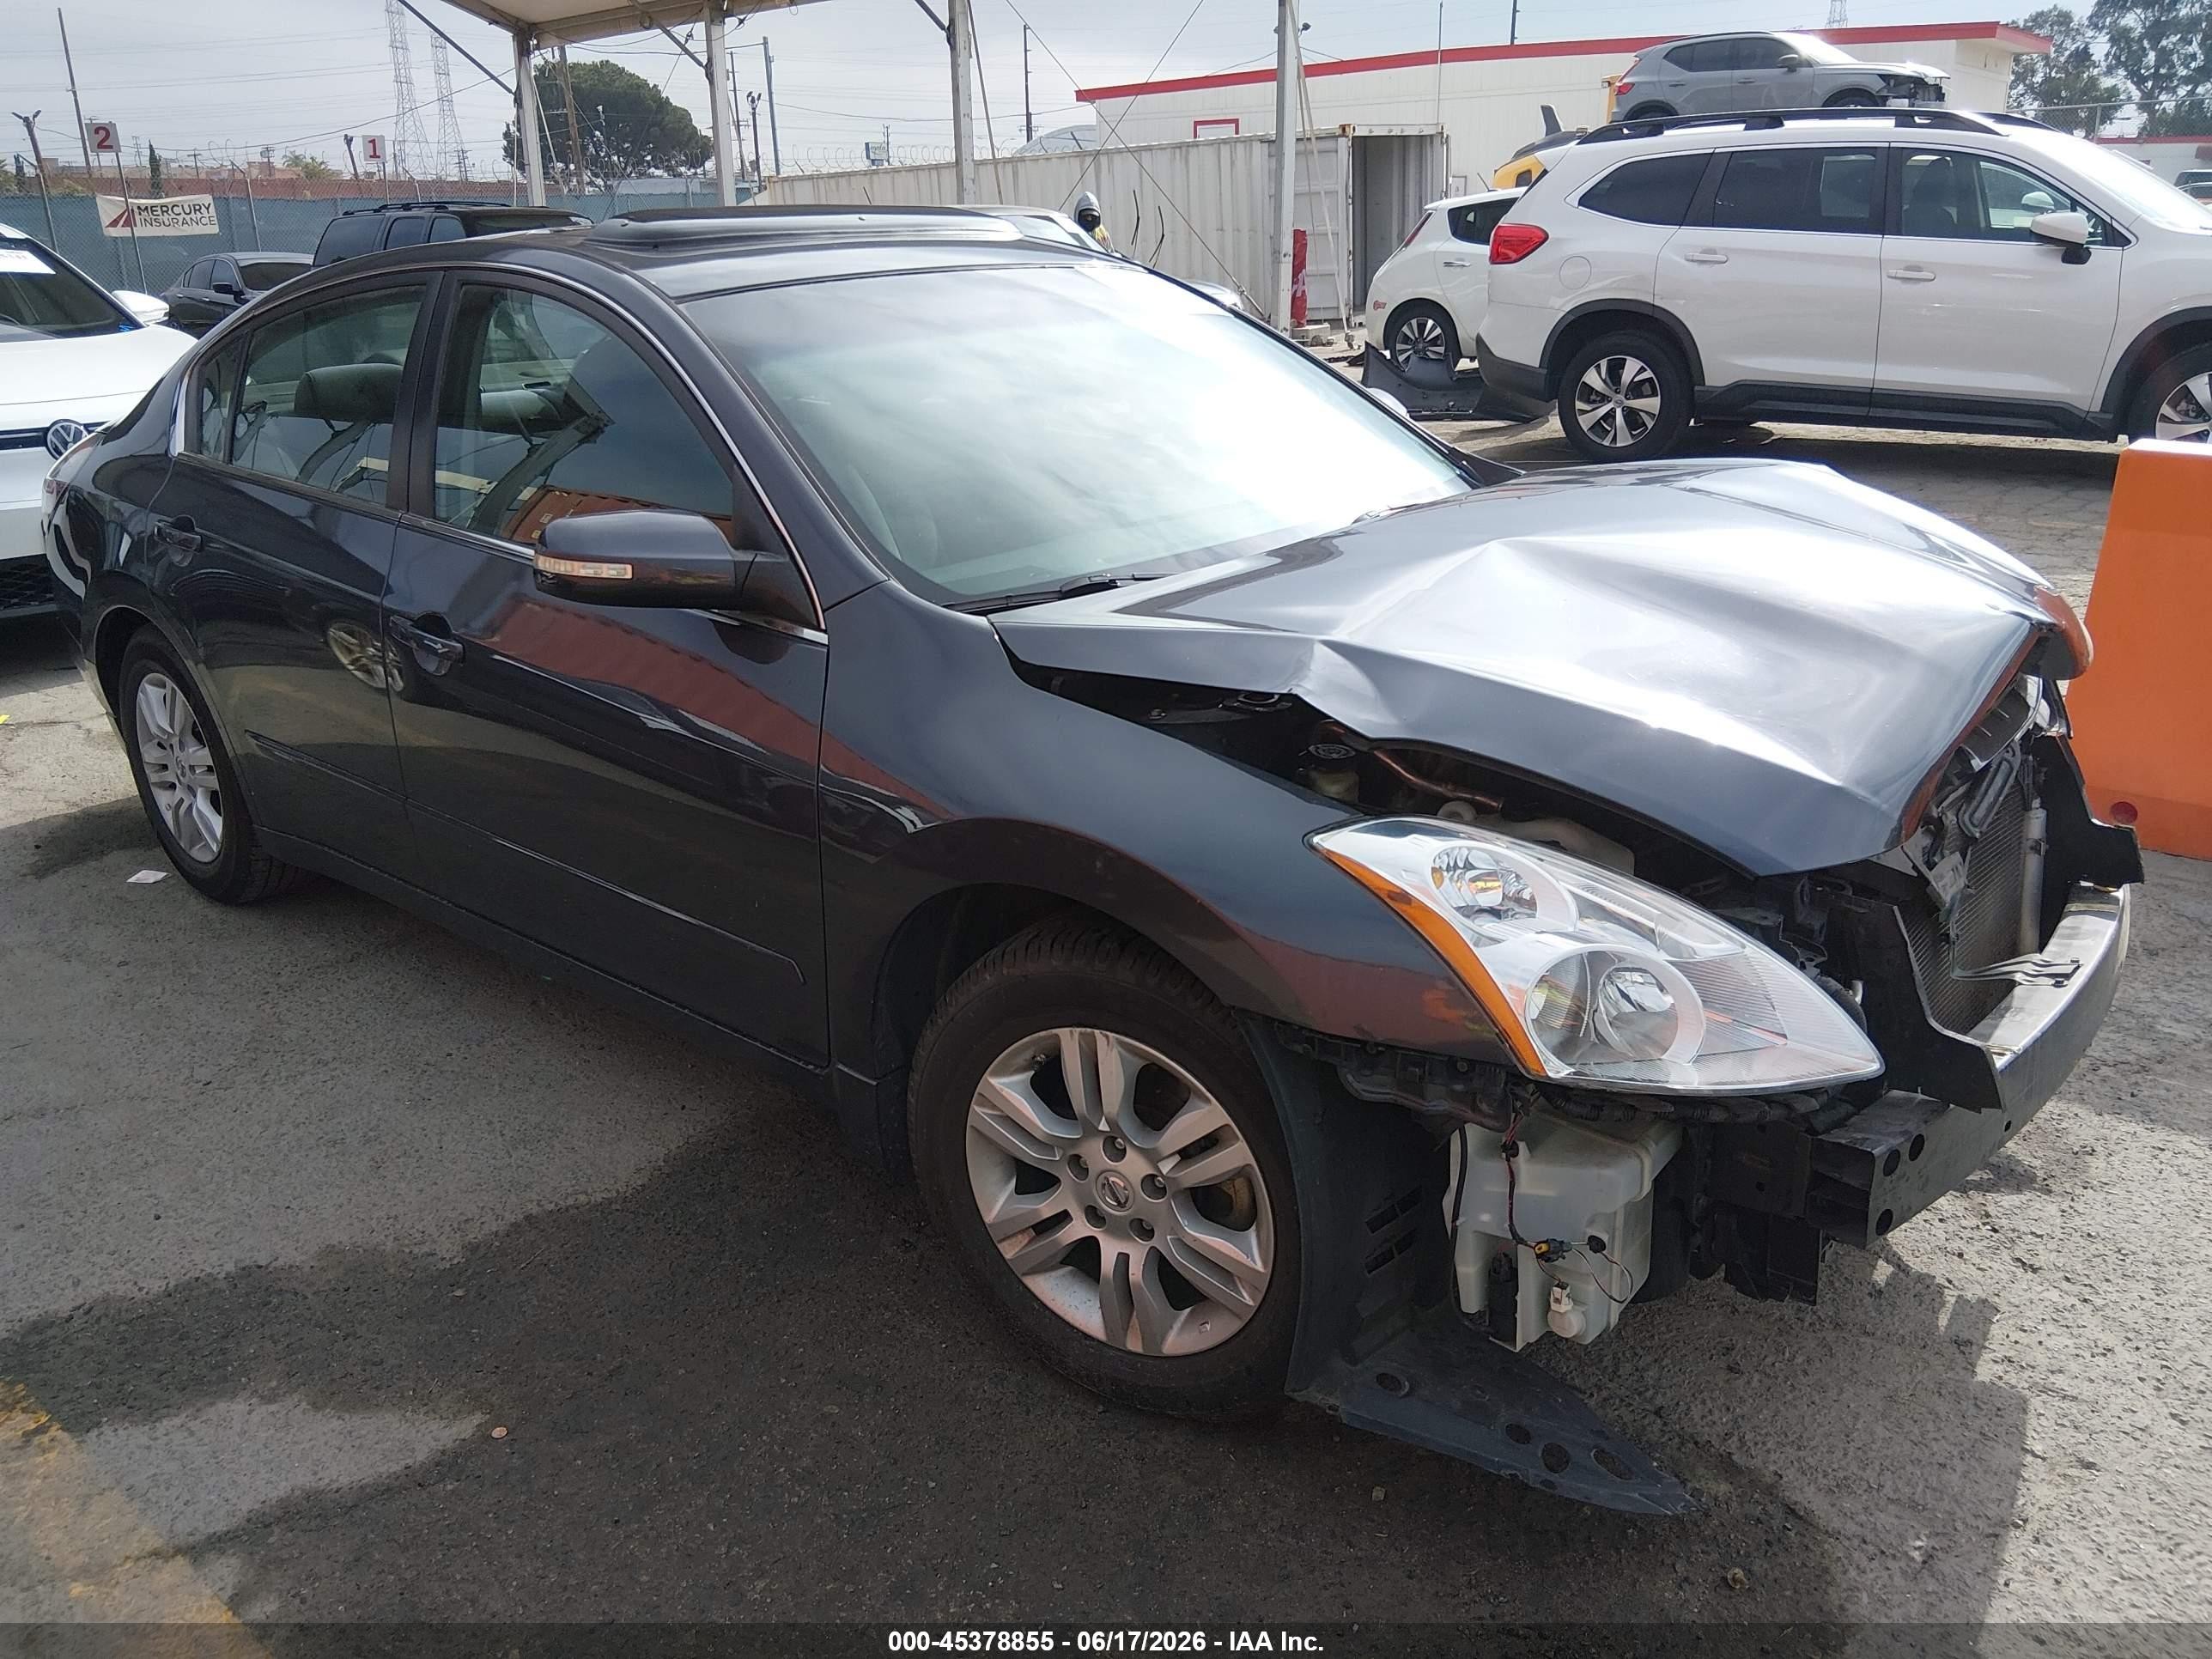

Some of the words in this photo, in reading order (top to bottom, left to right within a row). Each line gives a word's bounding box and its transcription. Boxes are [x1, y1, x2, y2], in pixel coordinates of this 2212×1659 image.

[94, 126, 113, 149] 2
[368, 138, 380, 159] 1
[137, 203, 211, 217] MERCURY
[138, 216, 216, 228] INSURANCE
